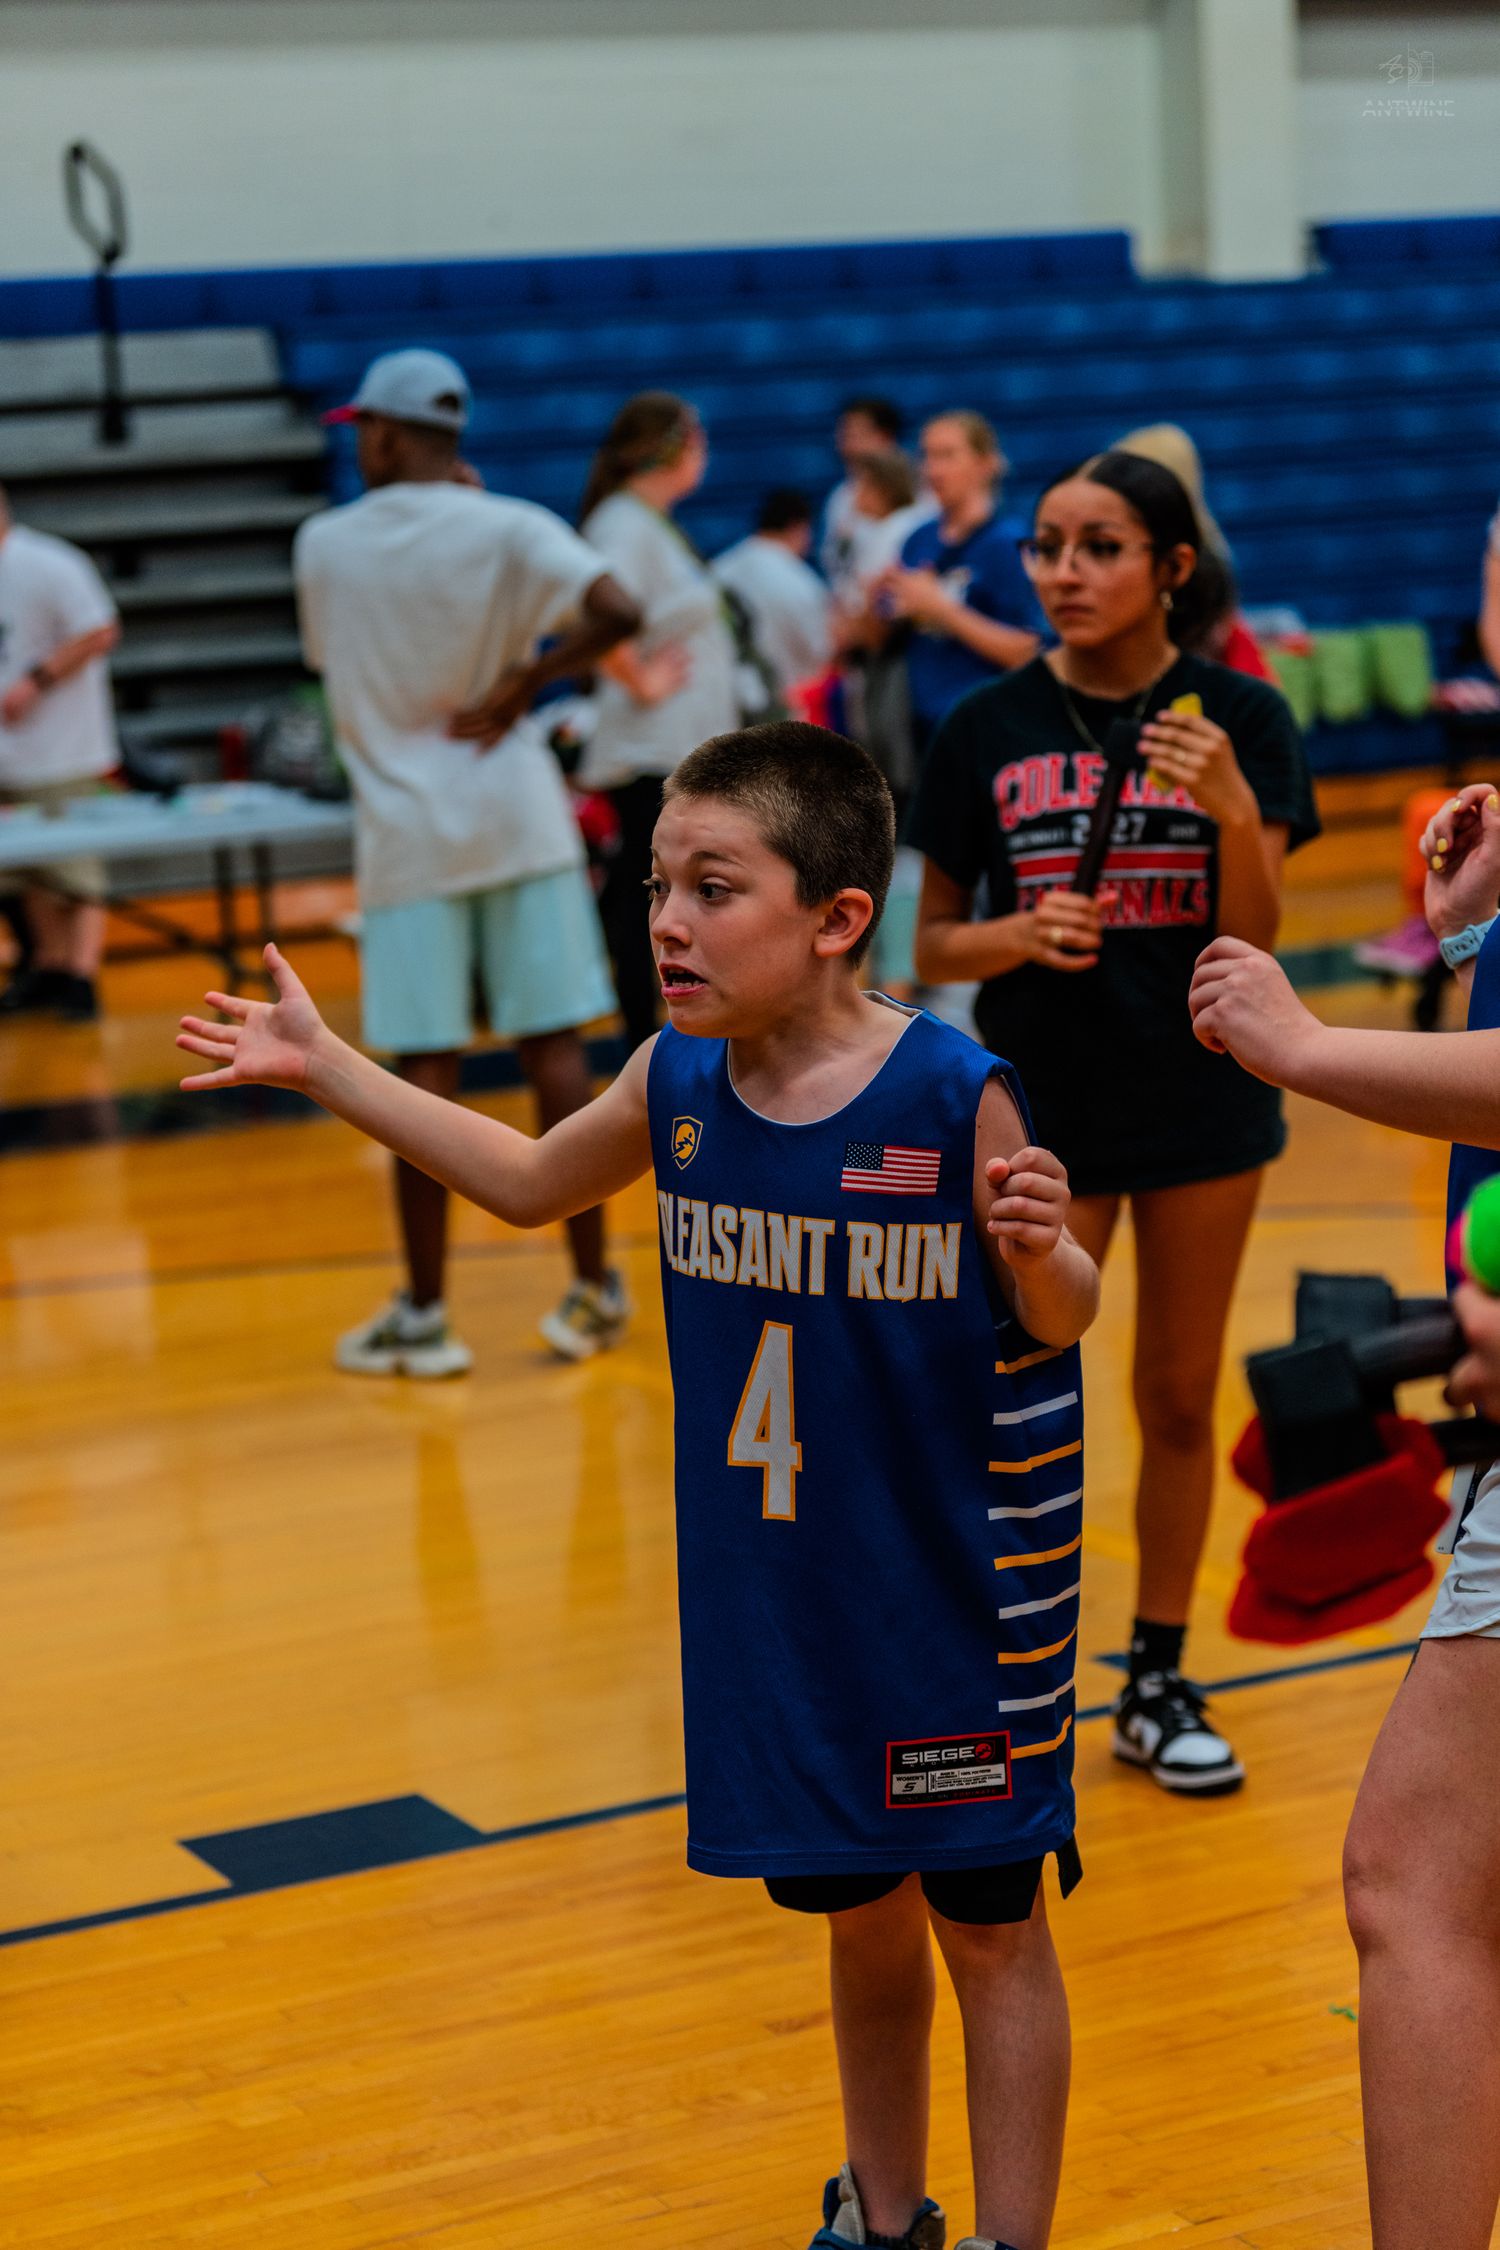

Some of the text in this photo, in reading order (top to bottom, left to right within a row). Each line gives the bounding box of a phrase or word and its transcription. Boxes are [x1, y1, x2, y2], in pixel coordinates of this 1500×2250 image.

[1071, 812, 1147, 846] 227
[847, 1221, 963, 1303] RUN
[727, 1319, 803, 1522] 4
[902, 1746, 975, 1765] SIEGE
[902, 1782, 917, 1792] S
